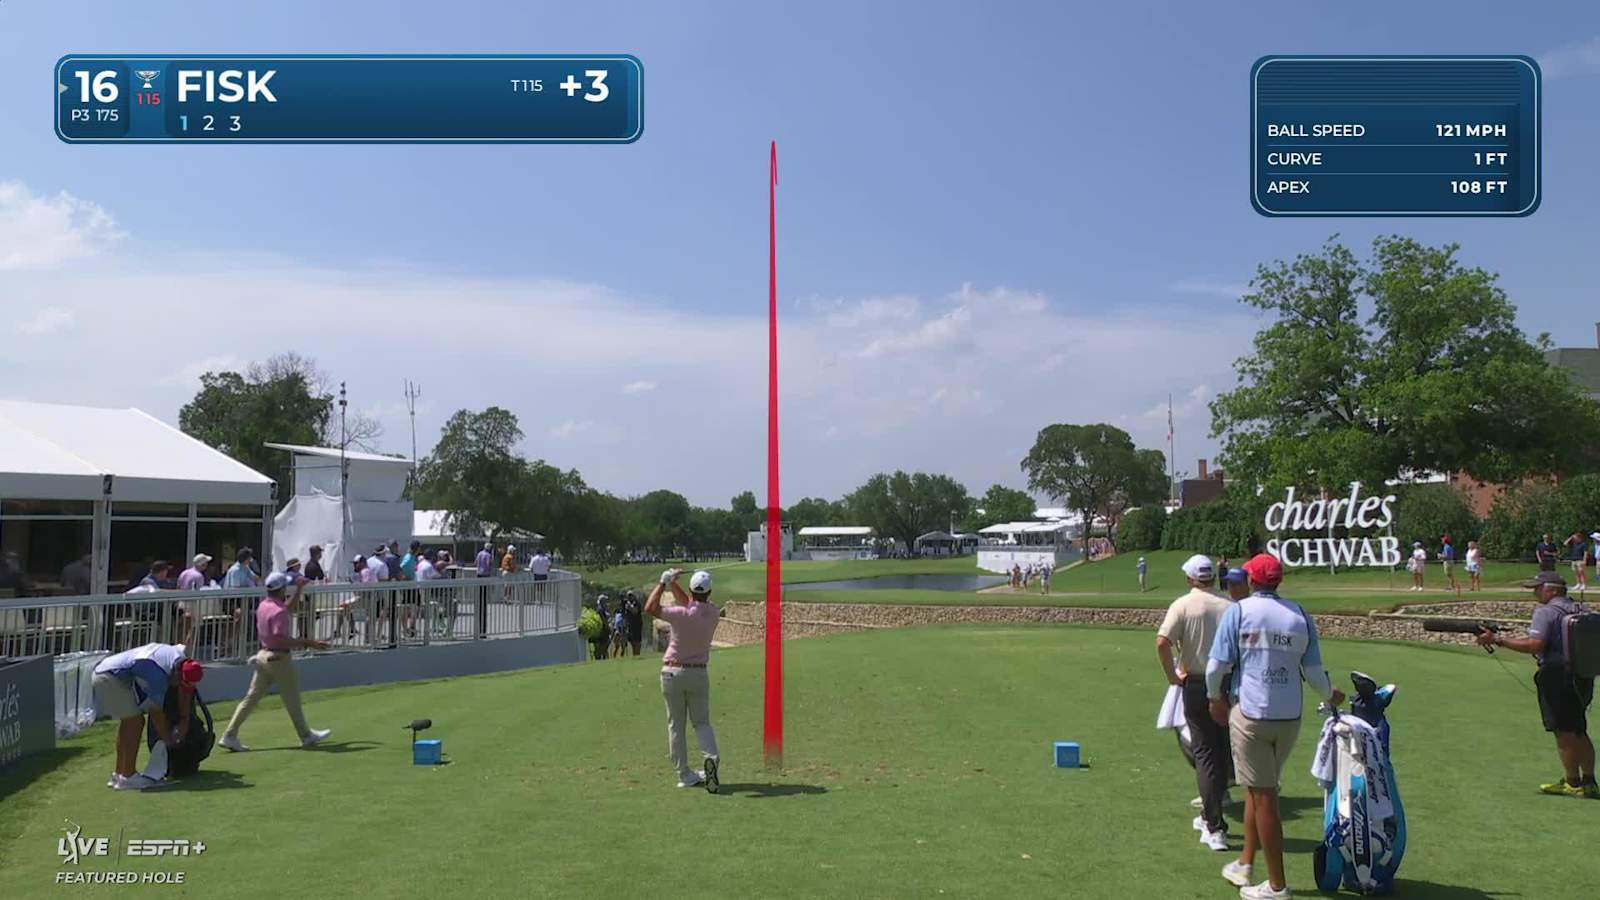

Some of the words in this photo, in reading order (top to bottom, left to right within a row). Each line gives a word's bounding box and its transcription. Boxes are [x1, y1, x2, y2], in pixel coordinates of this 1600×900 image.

[1264, 481, 1397, 531] charles
[1266, 536, 1401, 567] SCHWAB
[1273, 633, 1292, 647] FISK
